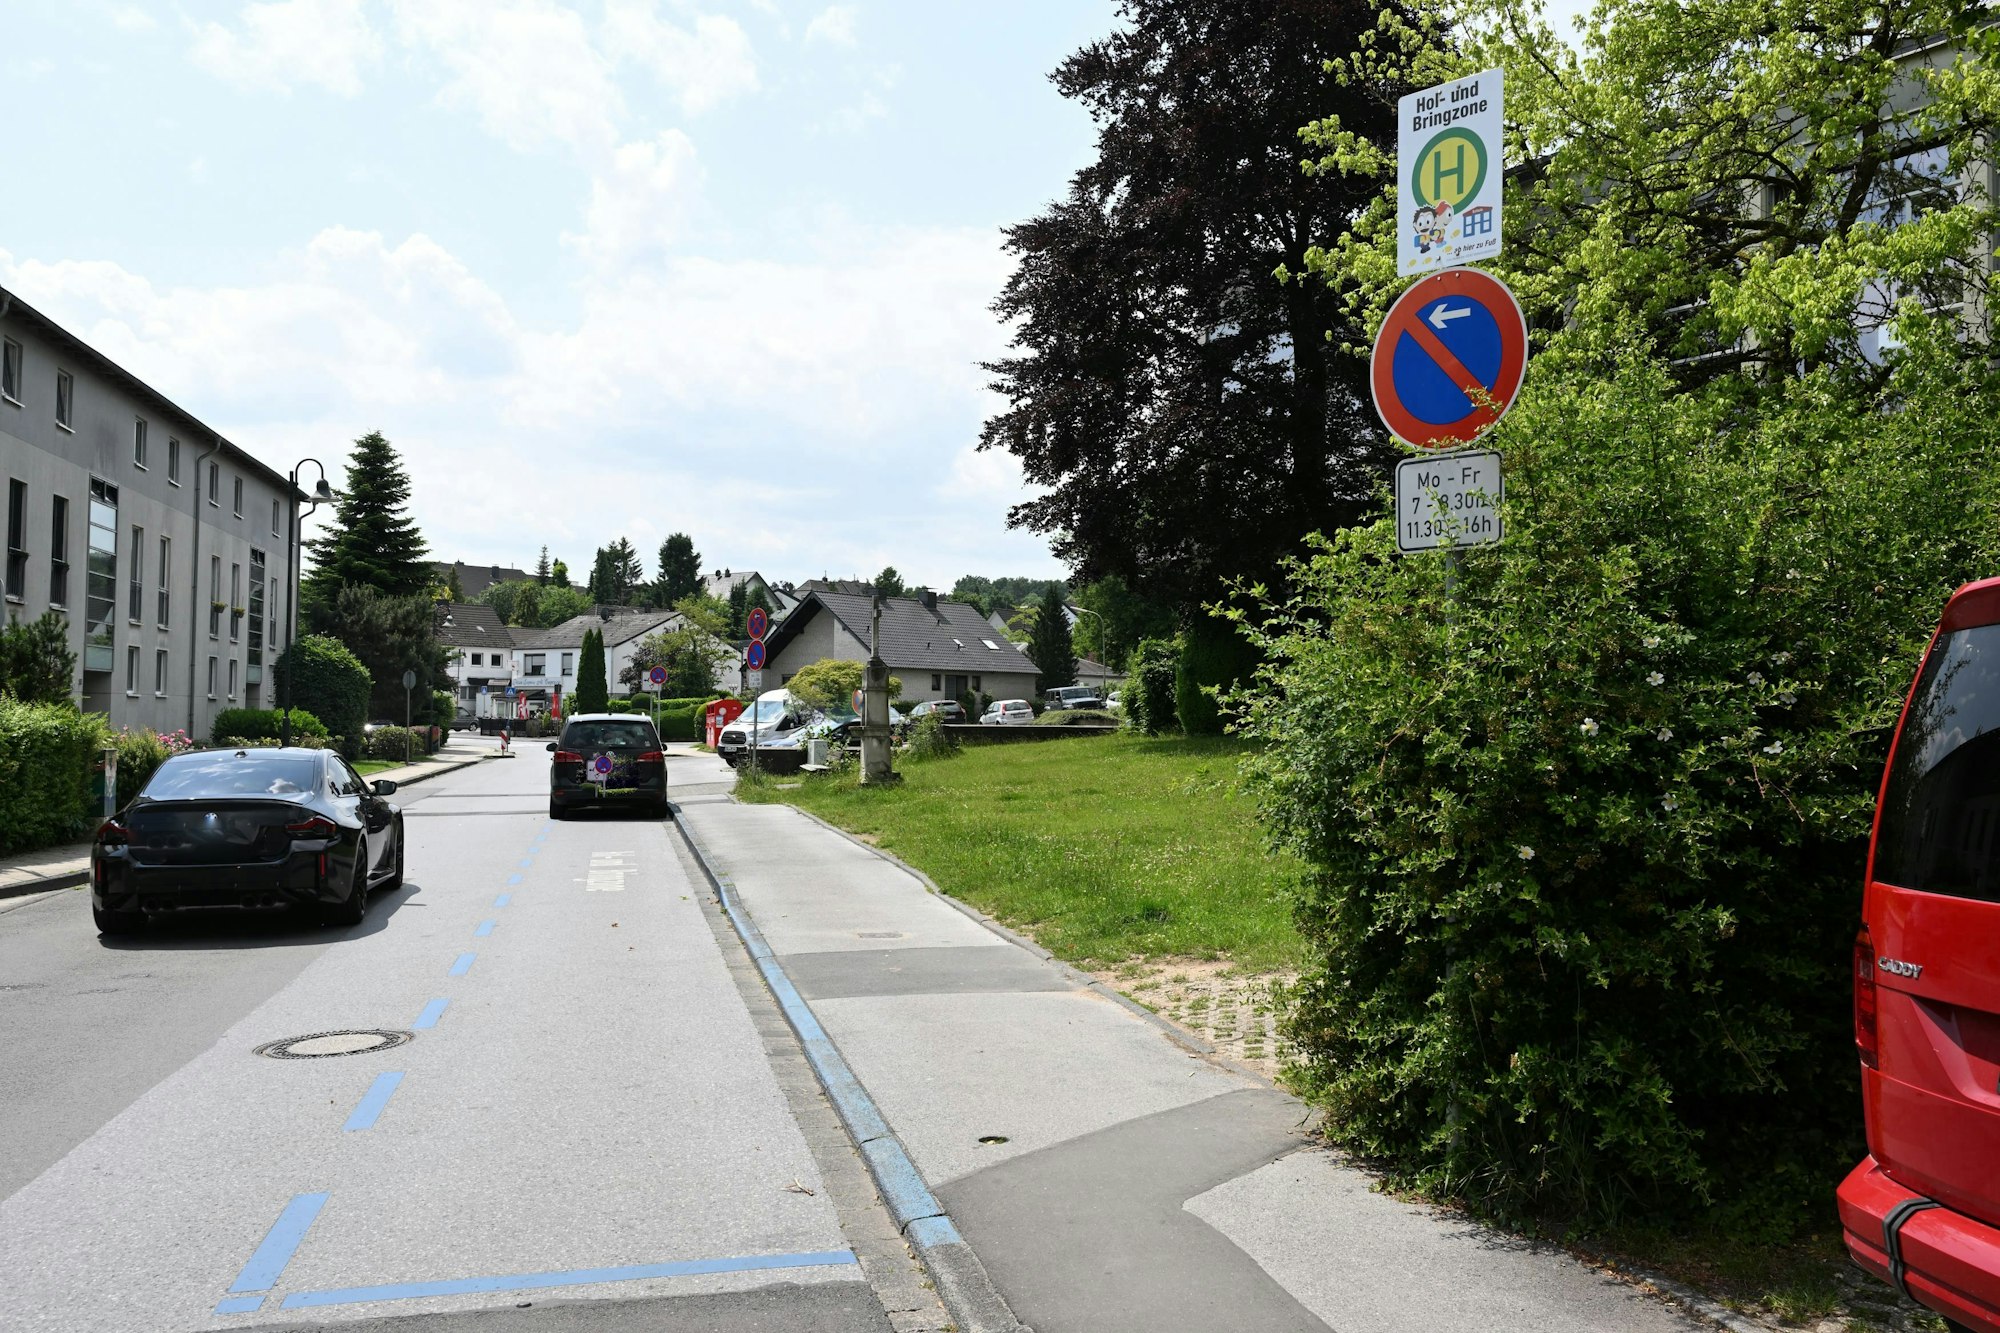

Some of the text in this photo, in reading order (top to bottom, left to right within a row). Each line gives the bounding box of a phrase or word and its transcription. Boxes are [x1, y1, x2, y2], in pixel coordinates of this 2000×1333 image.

[1451, 81, 1479, 103] und
[1413, 99, 1488, 132] Bringzone
[1433, 144, 1464, 201] H
[1463, 243, 1475, 253] hier
[1476, 241, 1483, 249] zu
[1418, 471, 1440, 490] Mo
[1462, 466, 1481, 484] Fr
[1412, 497, 1420, 514] 7
[1407, 519, 1442, 539] 11.30
[1463, 515, 1491, 534] 16h
[1878, 956, 1923, 980] CADDY
